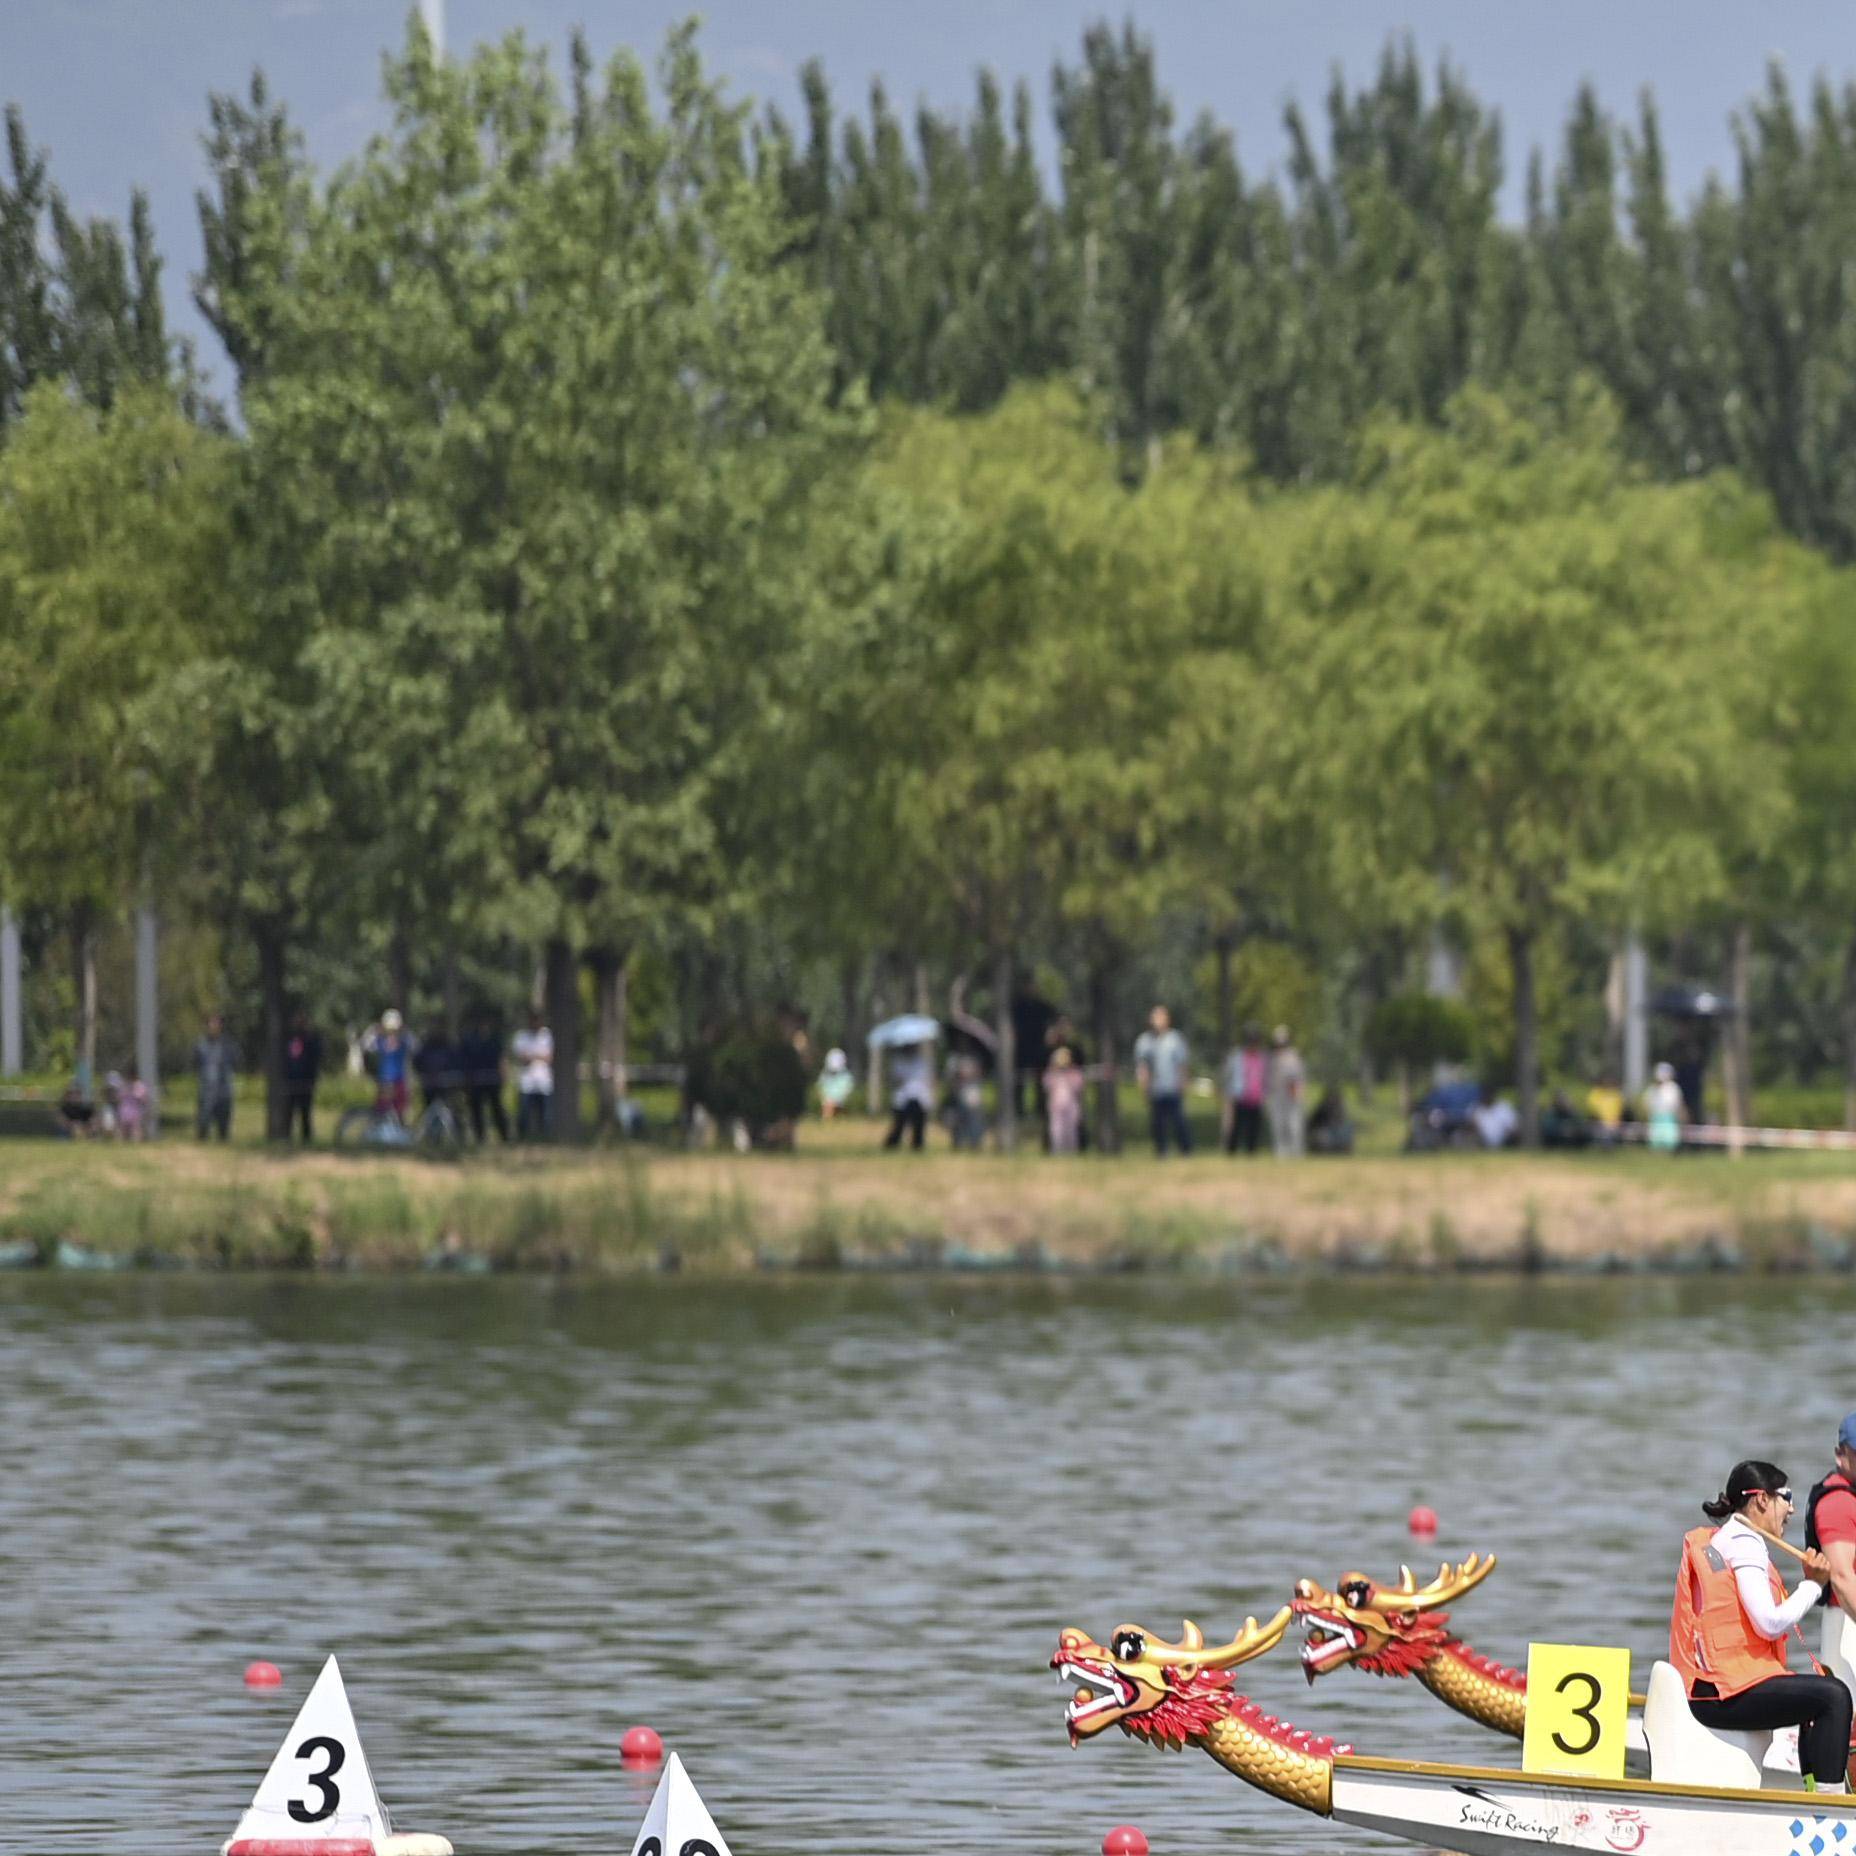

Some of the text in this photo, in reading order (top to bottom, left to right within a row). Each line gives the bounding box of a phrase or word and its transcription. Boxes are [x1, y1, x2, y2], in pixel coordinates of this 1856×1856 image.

[1551, 1672, 1602, 1755] 3
[286, 1736, 346, 1824] 3
[1459, 1804, 1559, 1842] Swift Racing
